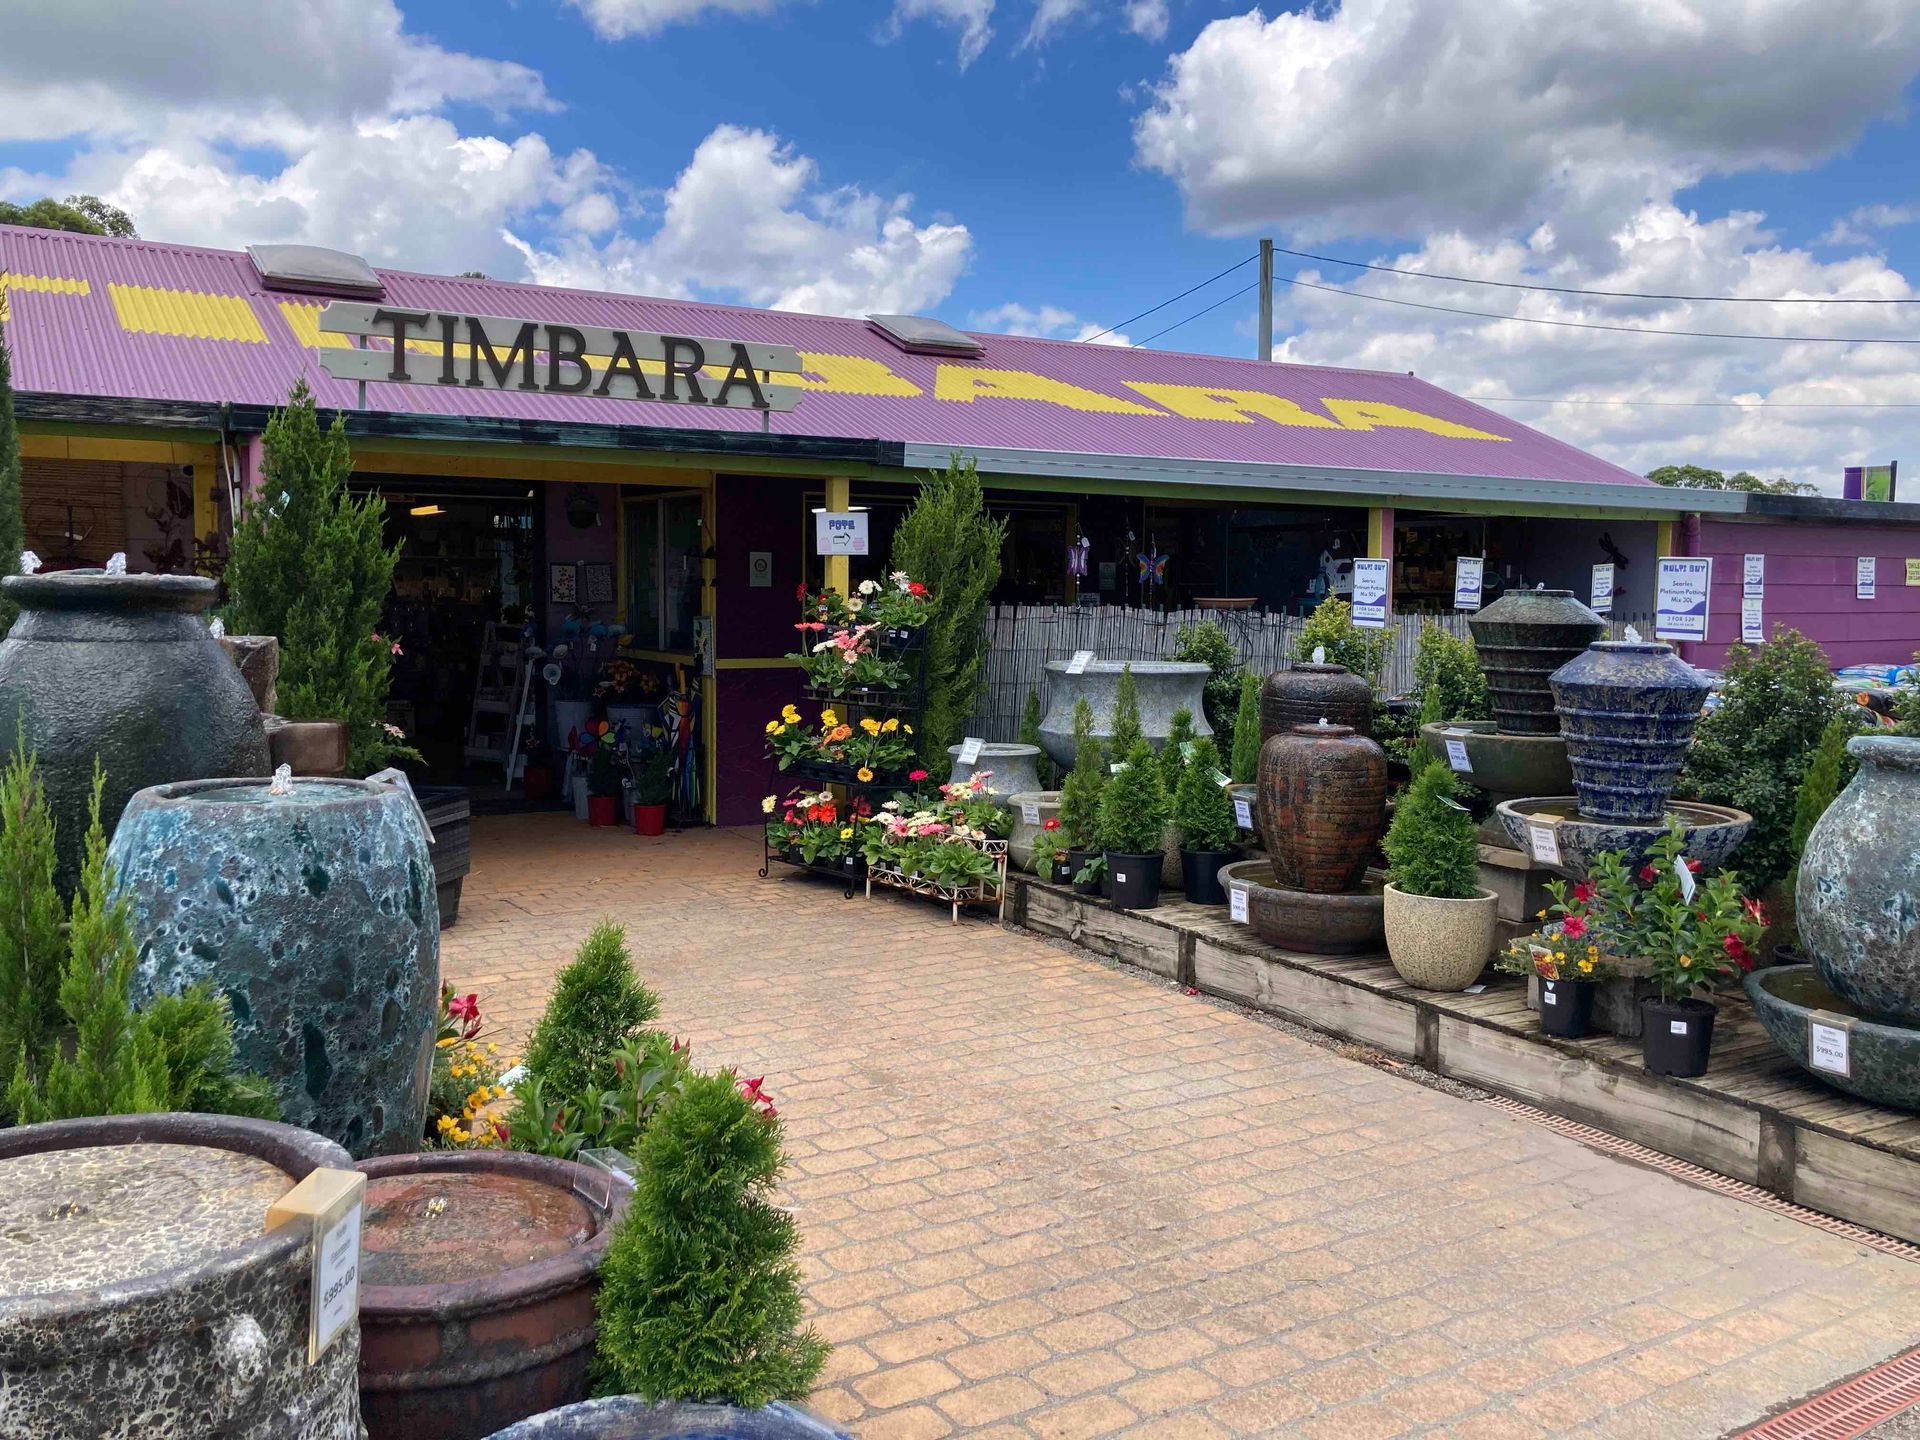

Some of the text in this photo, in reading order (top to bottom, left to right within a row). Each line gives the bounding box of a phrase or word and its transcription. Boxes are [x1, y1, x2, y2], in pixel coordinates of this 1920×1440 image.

[372, 307, 770, 409] TIMBARA
[1663, 564, 1706, 573] MULTI BUY
[1685, 588, 1706, 596] Potting
[1816, 1045, 1843, 1058] $995.00
[324, 1265, 355, 1309] $995.00
